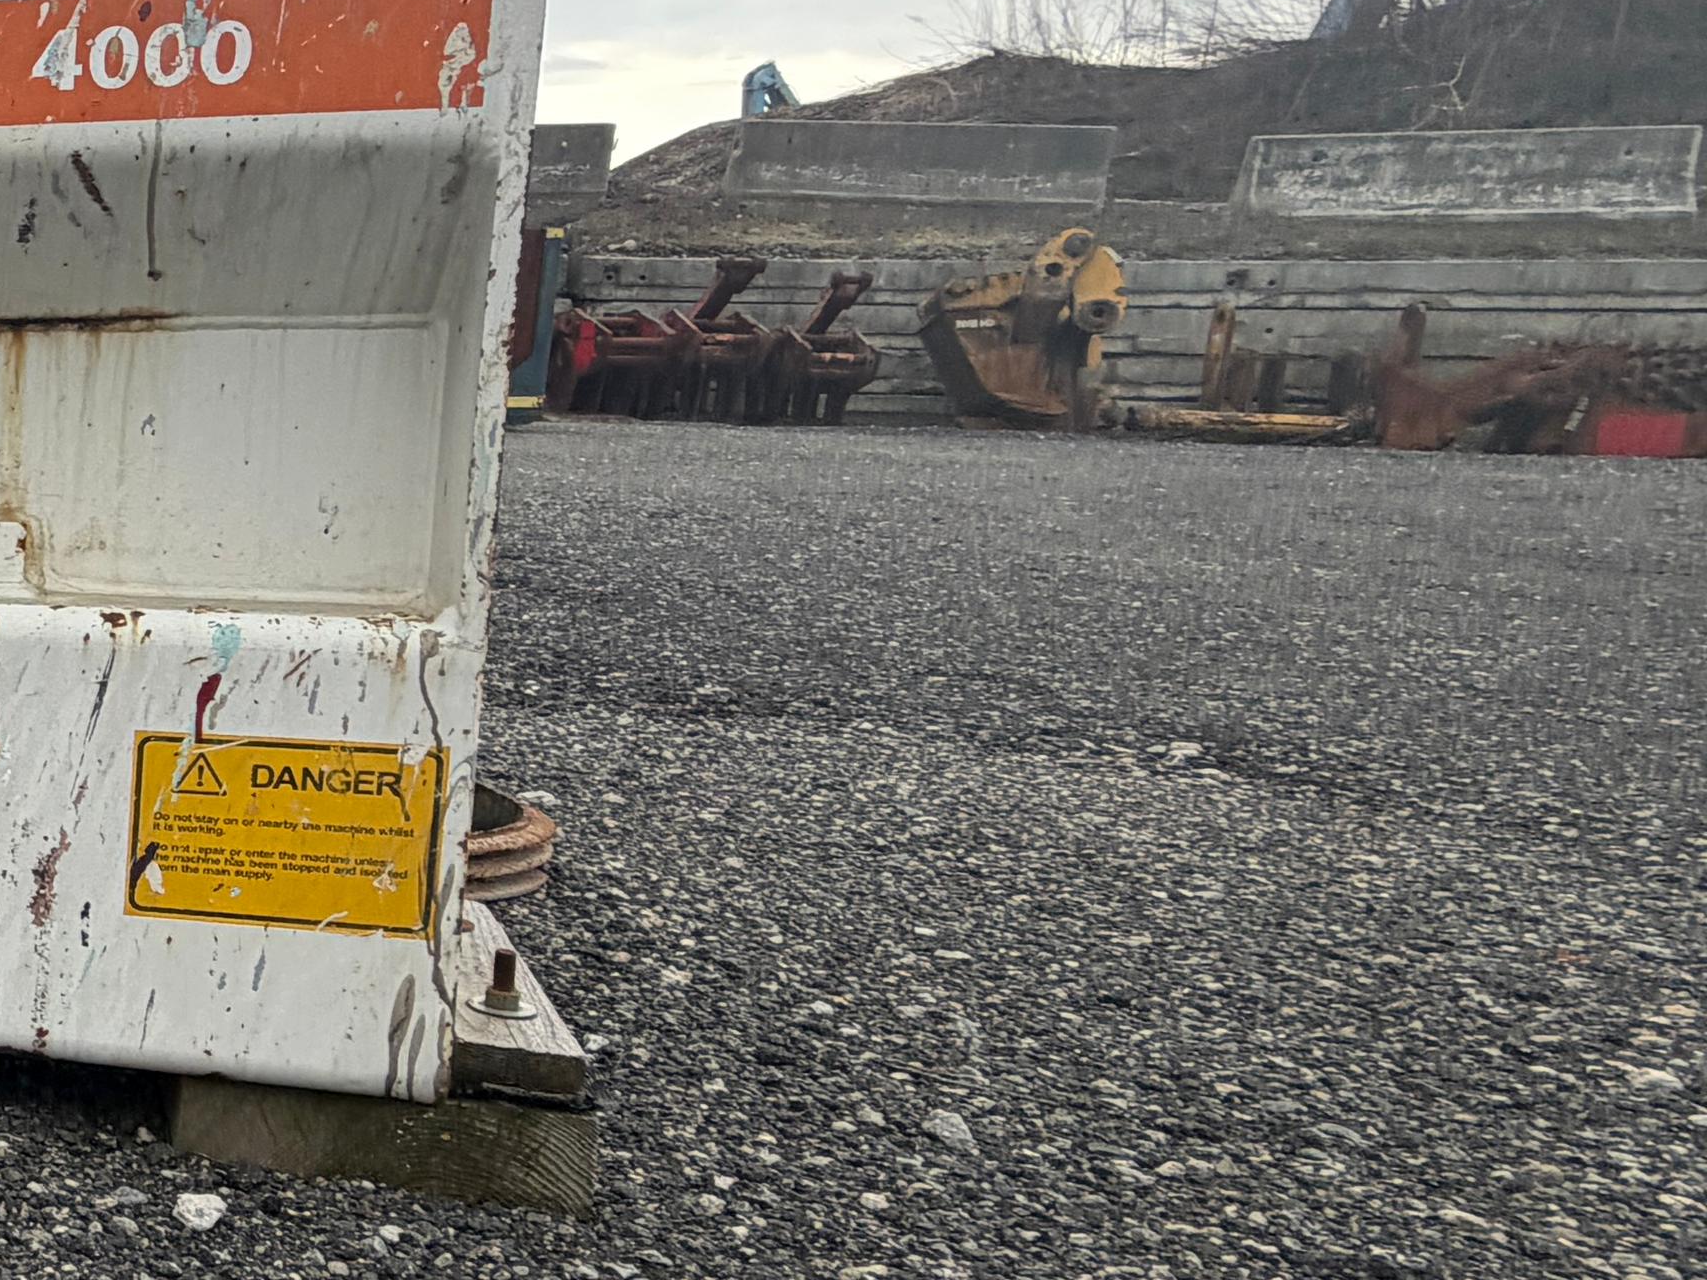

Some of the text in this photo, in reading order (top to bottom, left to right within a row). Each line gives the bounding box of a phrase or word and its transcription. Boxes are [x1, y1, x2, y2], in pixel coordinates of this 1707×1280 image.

[32, 20, 252, 90] 4000
[251, 764, 402, 796] DANGER
[153, 821, 225, 837] it is working.
[154, 812, 170, 821] Do
[174, 814, 192, 822] not
[193, 814, 220, 826] stay
[242, 818, 255, 826] or
[258, 819, 298, 832] nearby
[325, 823, 375, 835] machine
[379, 826, 414, 837] whilst
[173, 853, 221, 865] machine
[249, 858, 277, 869] been
[282, 862, 329, 874] stopped
[334, 866, 356, 876] and
[360, 867, 408, 880] isolted
[193, 845, 226, 856] epair
[229, 848, 242, 857] or
[245, 849, 275, 859] enter
[278, 851, 297, 861] the
[355, 857, 394, 867] unles
[181, 864, 199, 873] the
[203, 867, 231, 876] main
[235, 869, 274, 881] supply.
